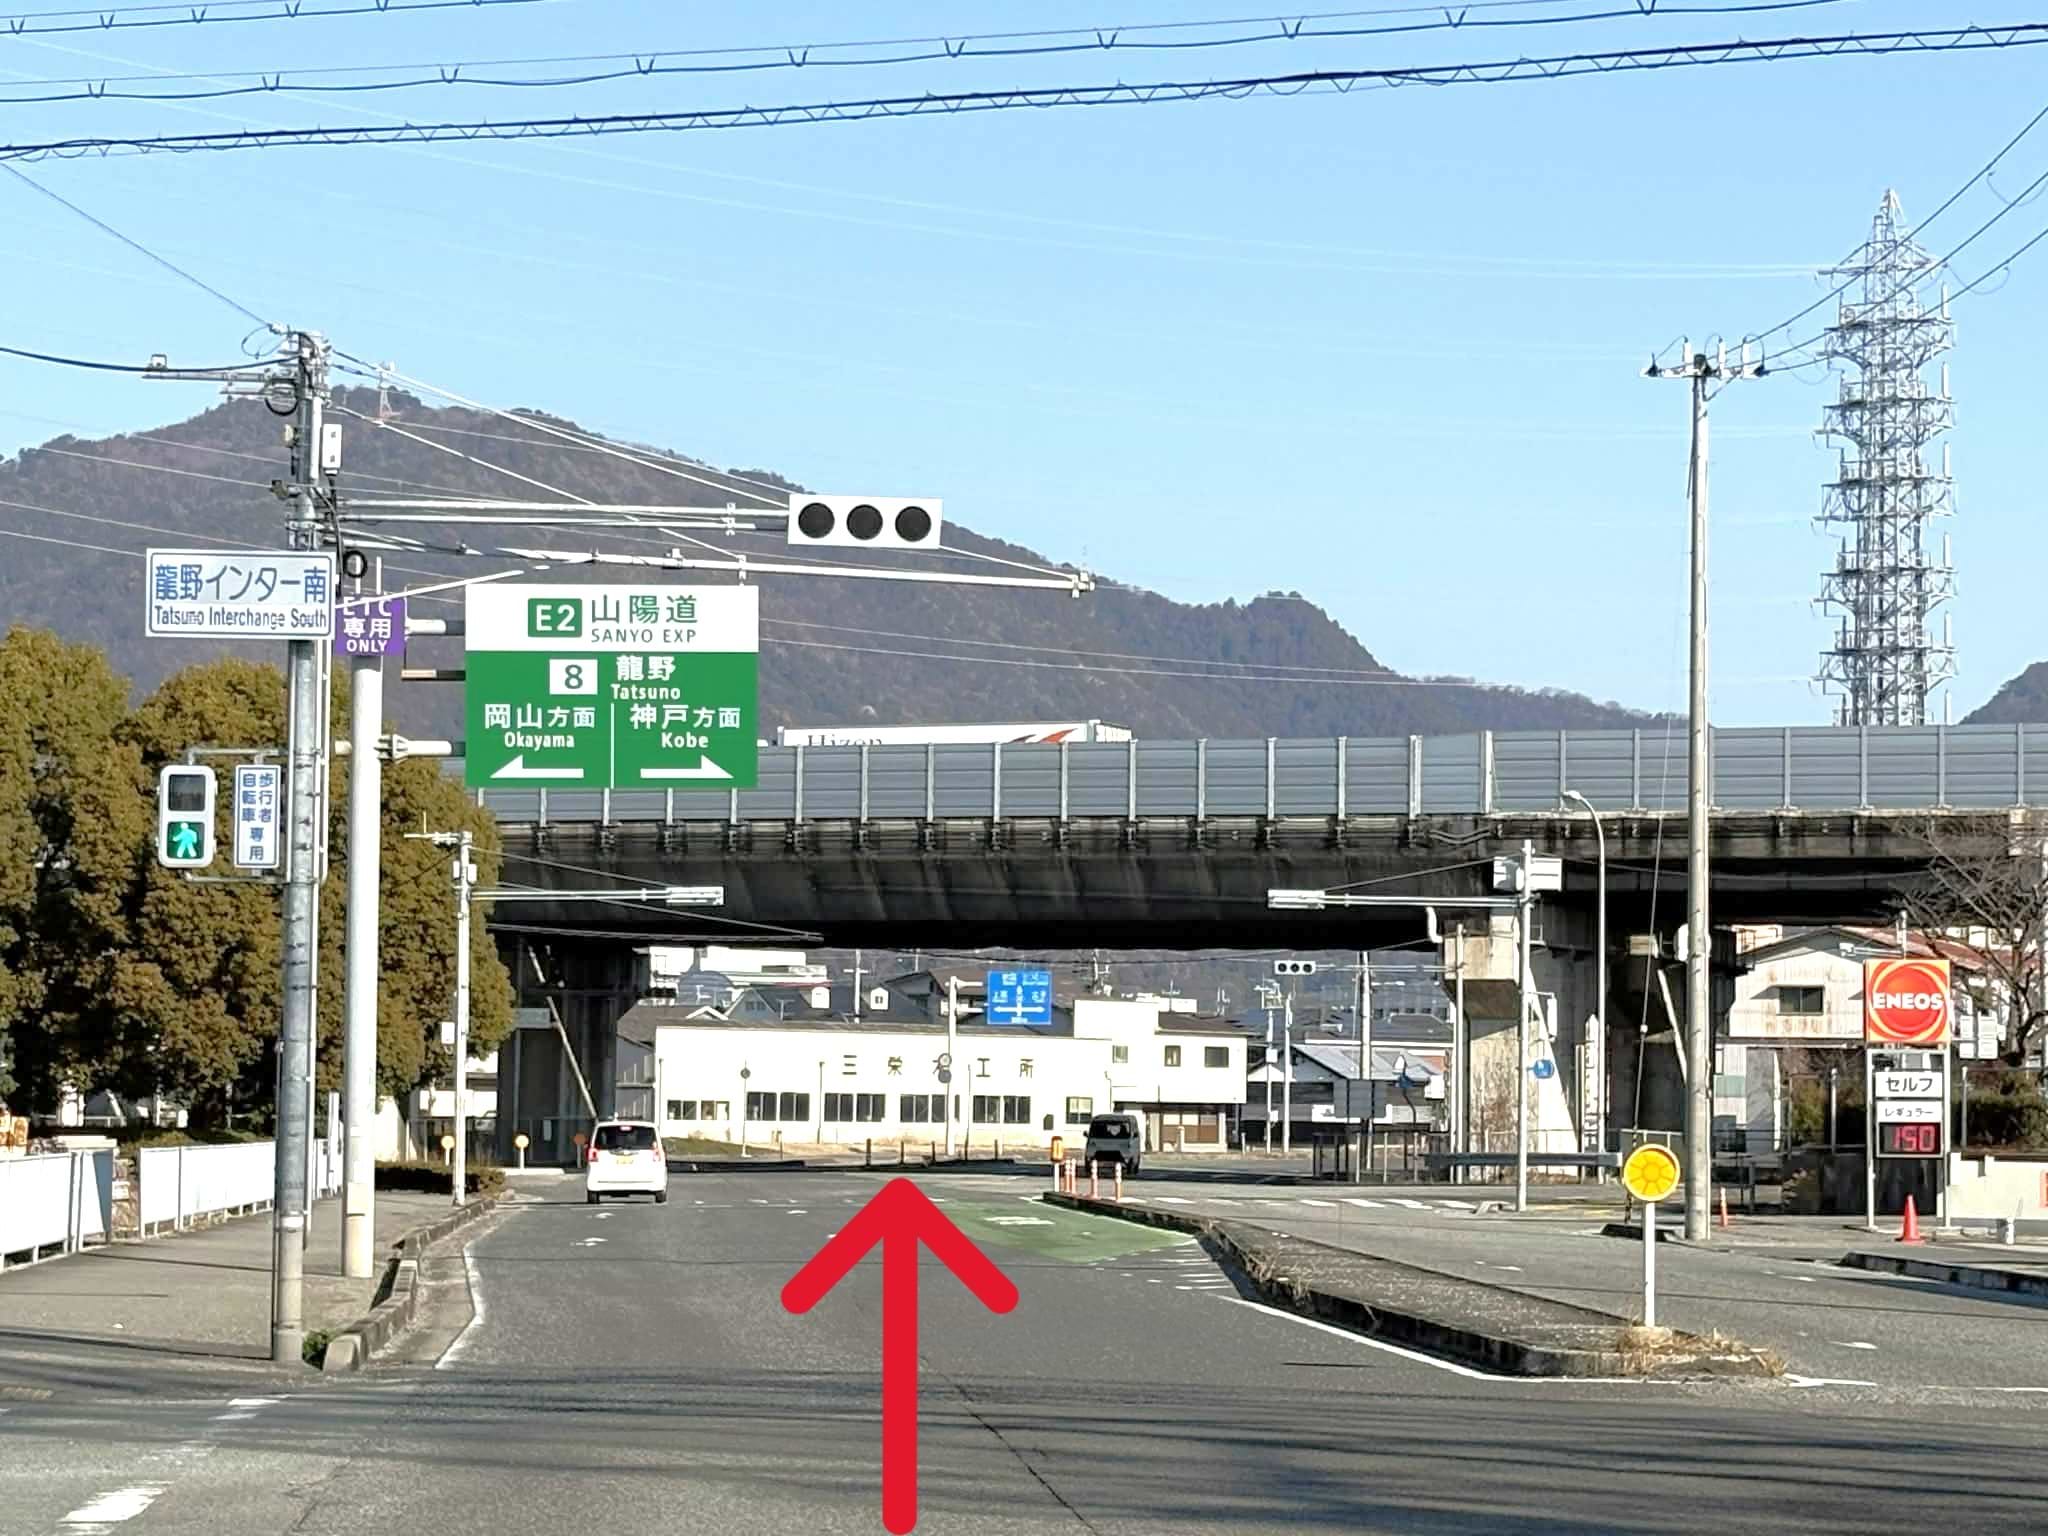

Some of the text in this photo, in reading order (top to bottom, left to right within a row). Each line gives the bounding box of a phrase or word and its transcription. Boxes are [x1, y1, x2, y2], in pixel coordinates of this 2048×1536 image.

[155, 563, 327, 604] 龍野インター南
[343, 596, 392, 617] ETC
[591, 594, 698, 624] 山陽道
[155, 606, 327, 630] Tatsuno Interchange South
[343, 617, 391, 638] 専用
[536, 604, 576, 632] E2
[346, 639, 388, 652] ONLY
[591, 629, 697, 643] SANYO EXP
[564, 664, 584, 689] 8
[616, 655, 676, 681] 龍野
[611, 683, 681, 700] Tatsuno
[484, 703, 596, 729] 岡山方面
[629, 703, 741, 729] 神戸方面
[504, 731, 575, 750] Okayama
[661, 732, 709, 748] Kobe
[259, 772, 274, 823] 歩行者
[249, 827, 265, 861] 専用
[1872, 992, 1944, 1010] ENEOS
[1885, 1076, 1934, 1093] セルフ
[1884, 1107, 1934, 1118] レギュラー
